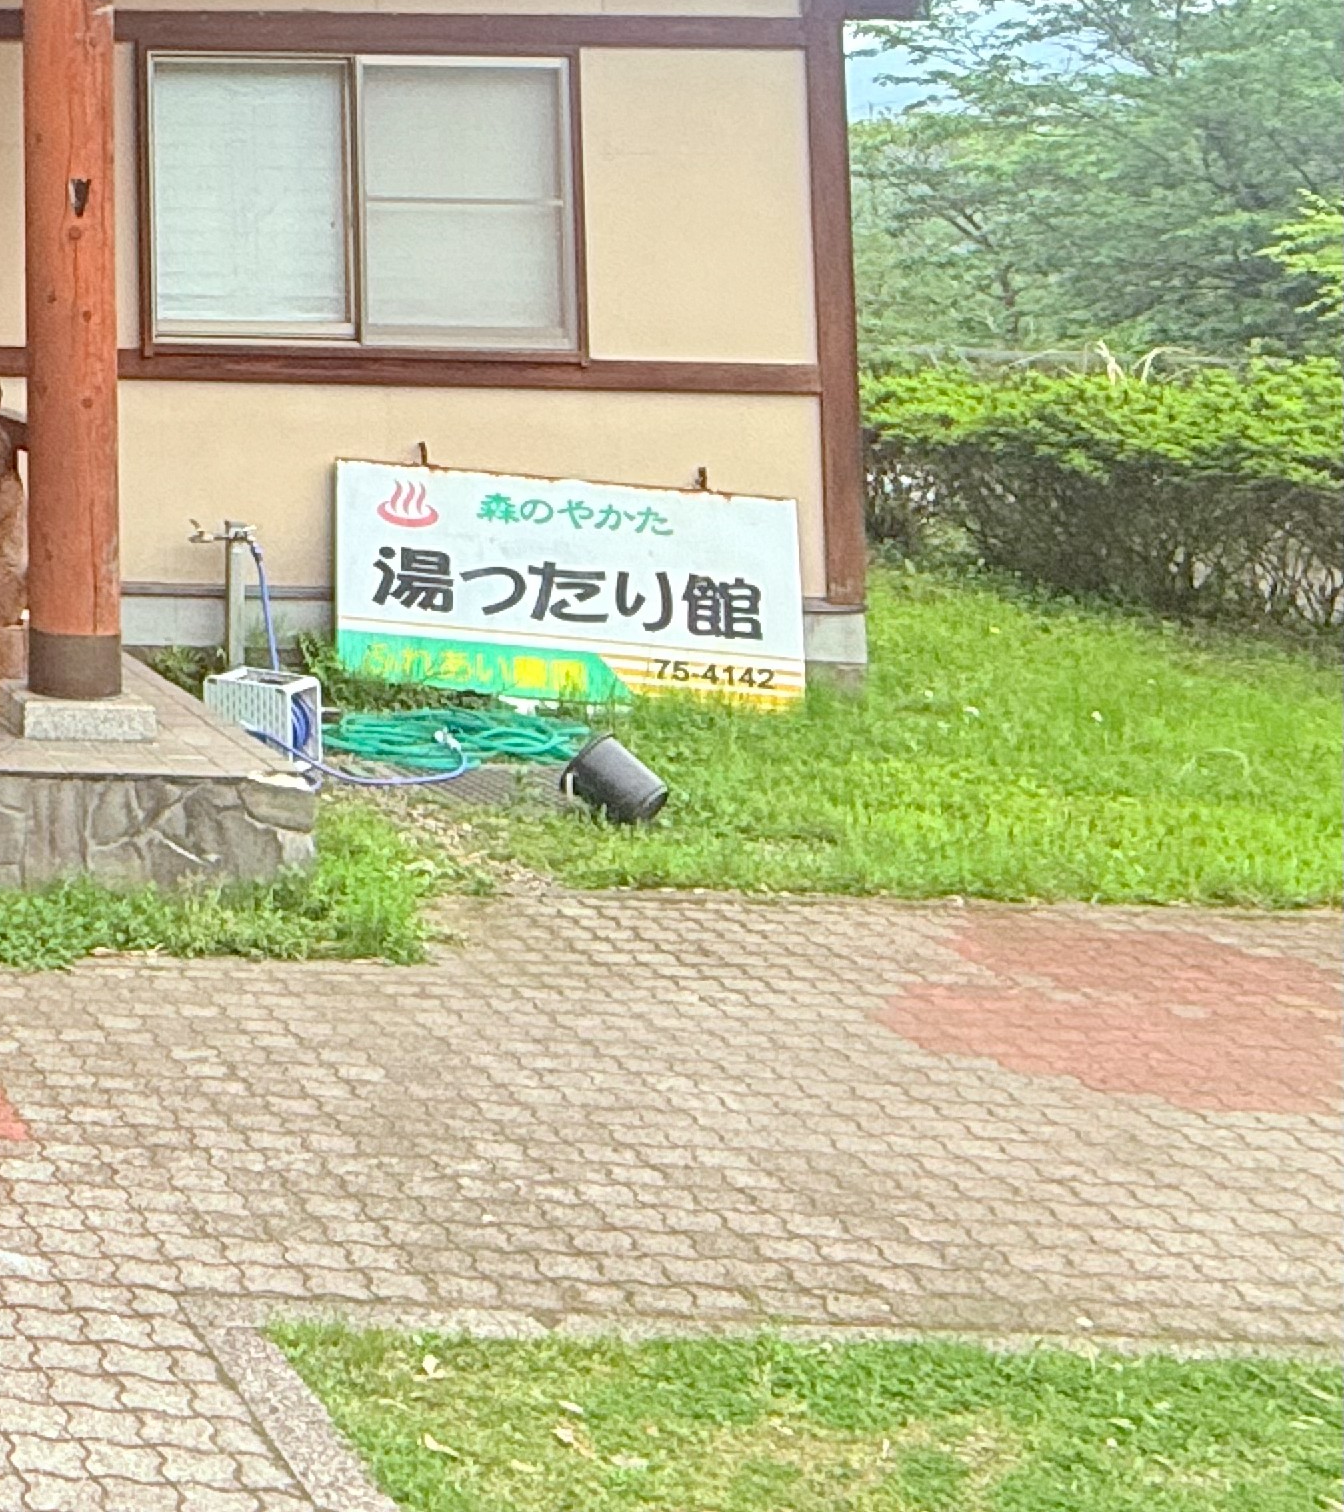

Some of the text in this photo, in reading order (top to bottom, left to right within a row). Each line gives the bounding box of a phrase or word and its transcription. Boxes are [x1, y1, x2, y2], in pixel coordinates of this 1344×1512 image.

[476, 492, 675, 537] 森のやかた
[372, 545, 764, 641] 湯ったり館
[652, 657, 776, 690] 75-4142
